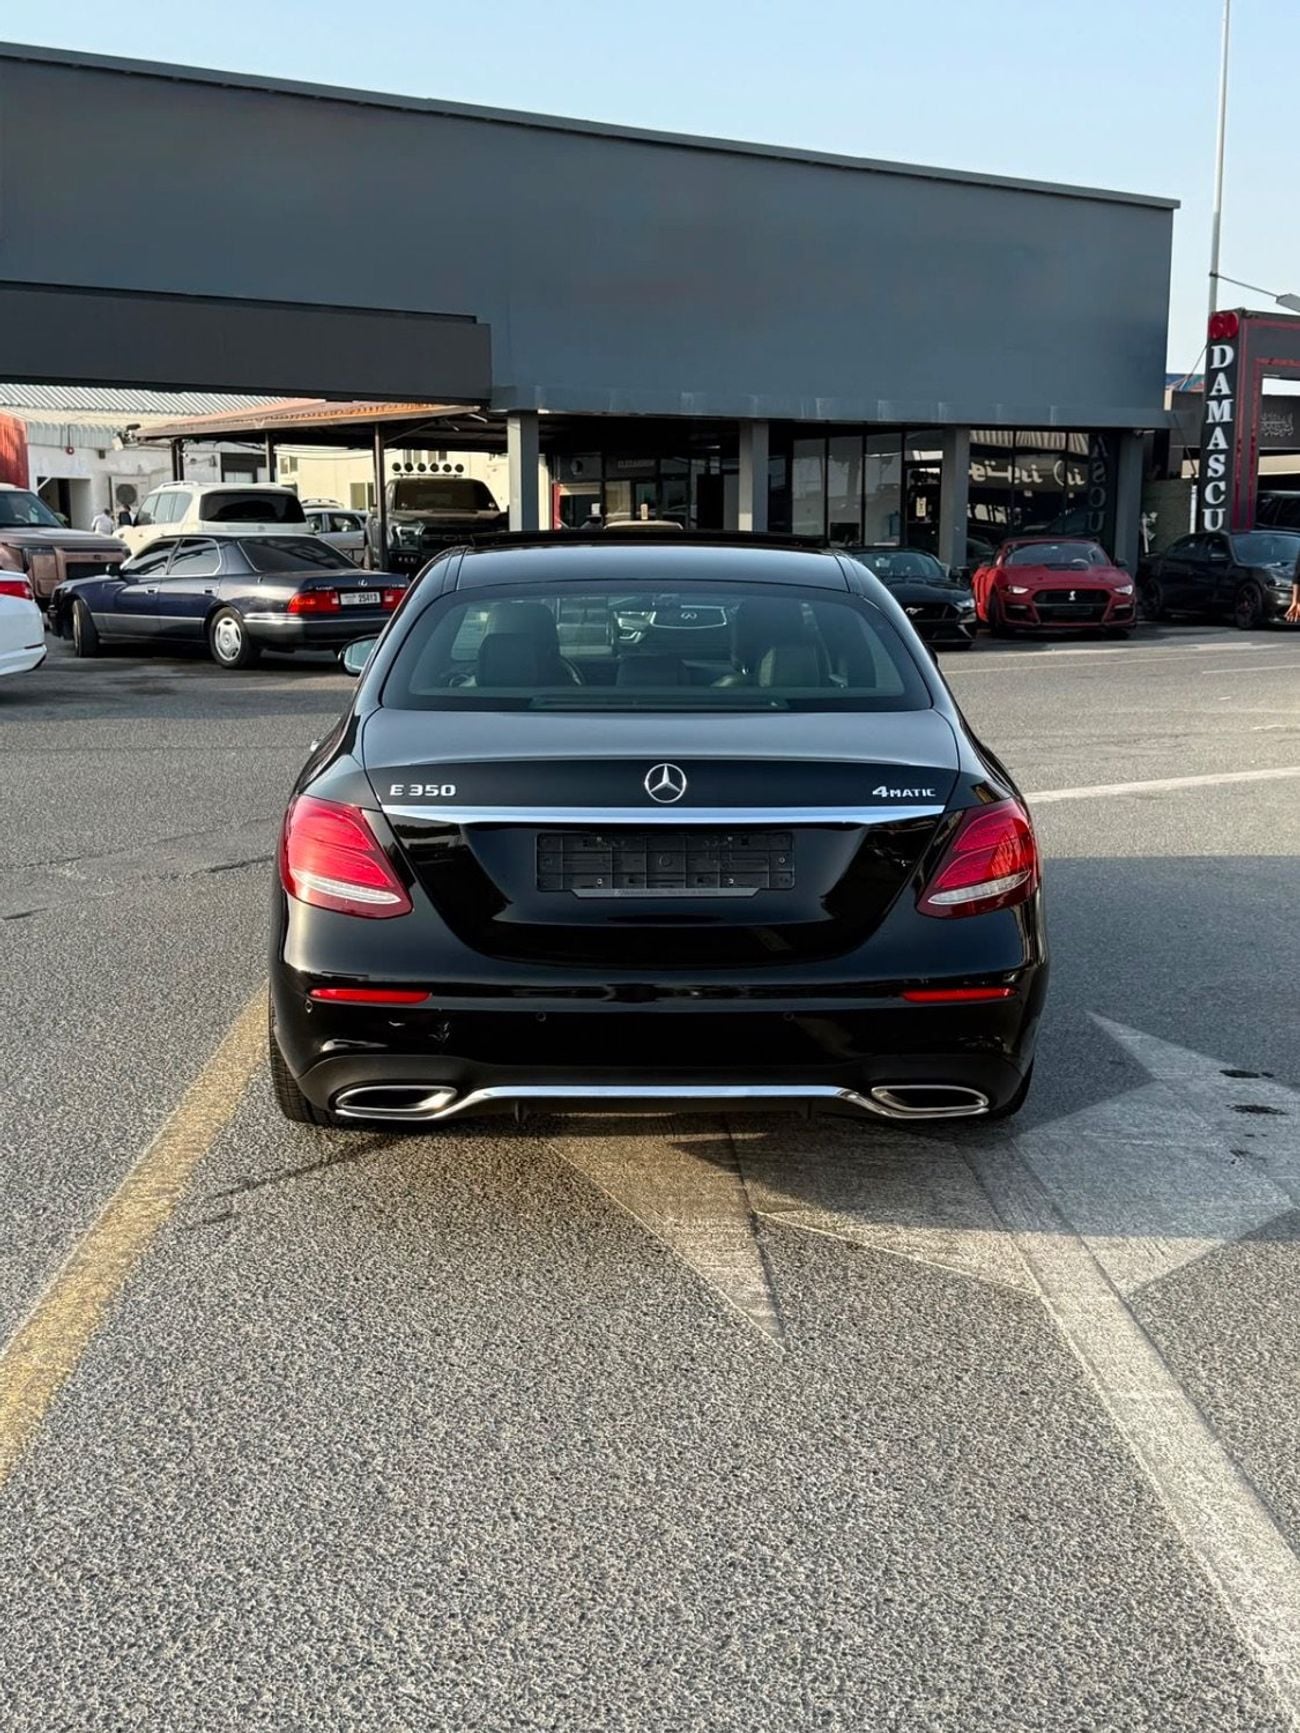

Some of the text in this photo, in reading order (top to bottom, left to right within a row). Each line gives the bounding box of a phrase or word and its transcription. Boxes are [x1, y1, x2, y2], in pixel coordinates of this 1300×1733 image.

[390, 784, 457, 796] E 350
[872, 785, 937, 798] 4MATIC
